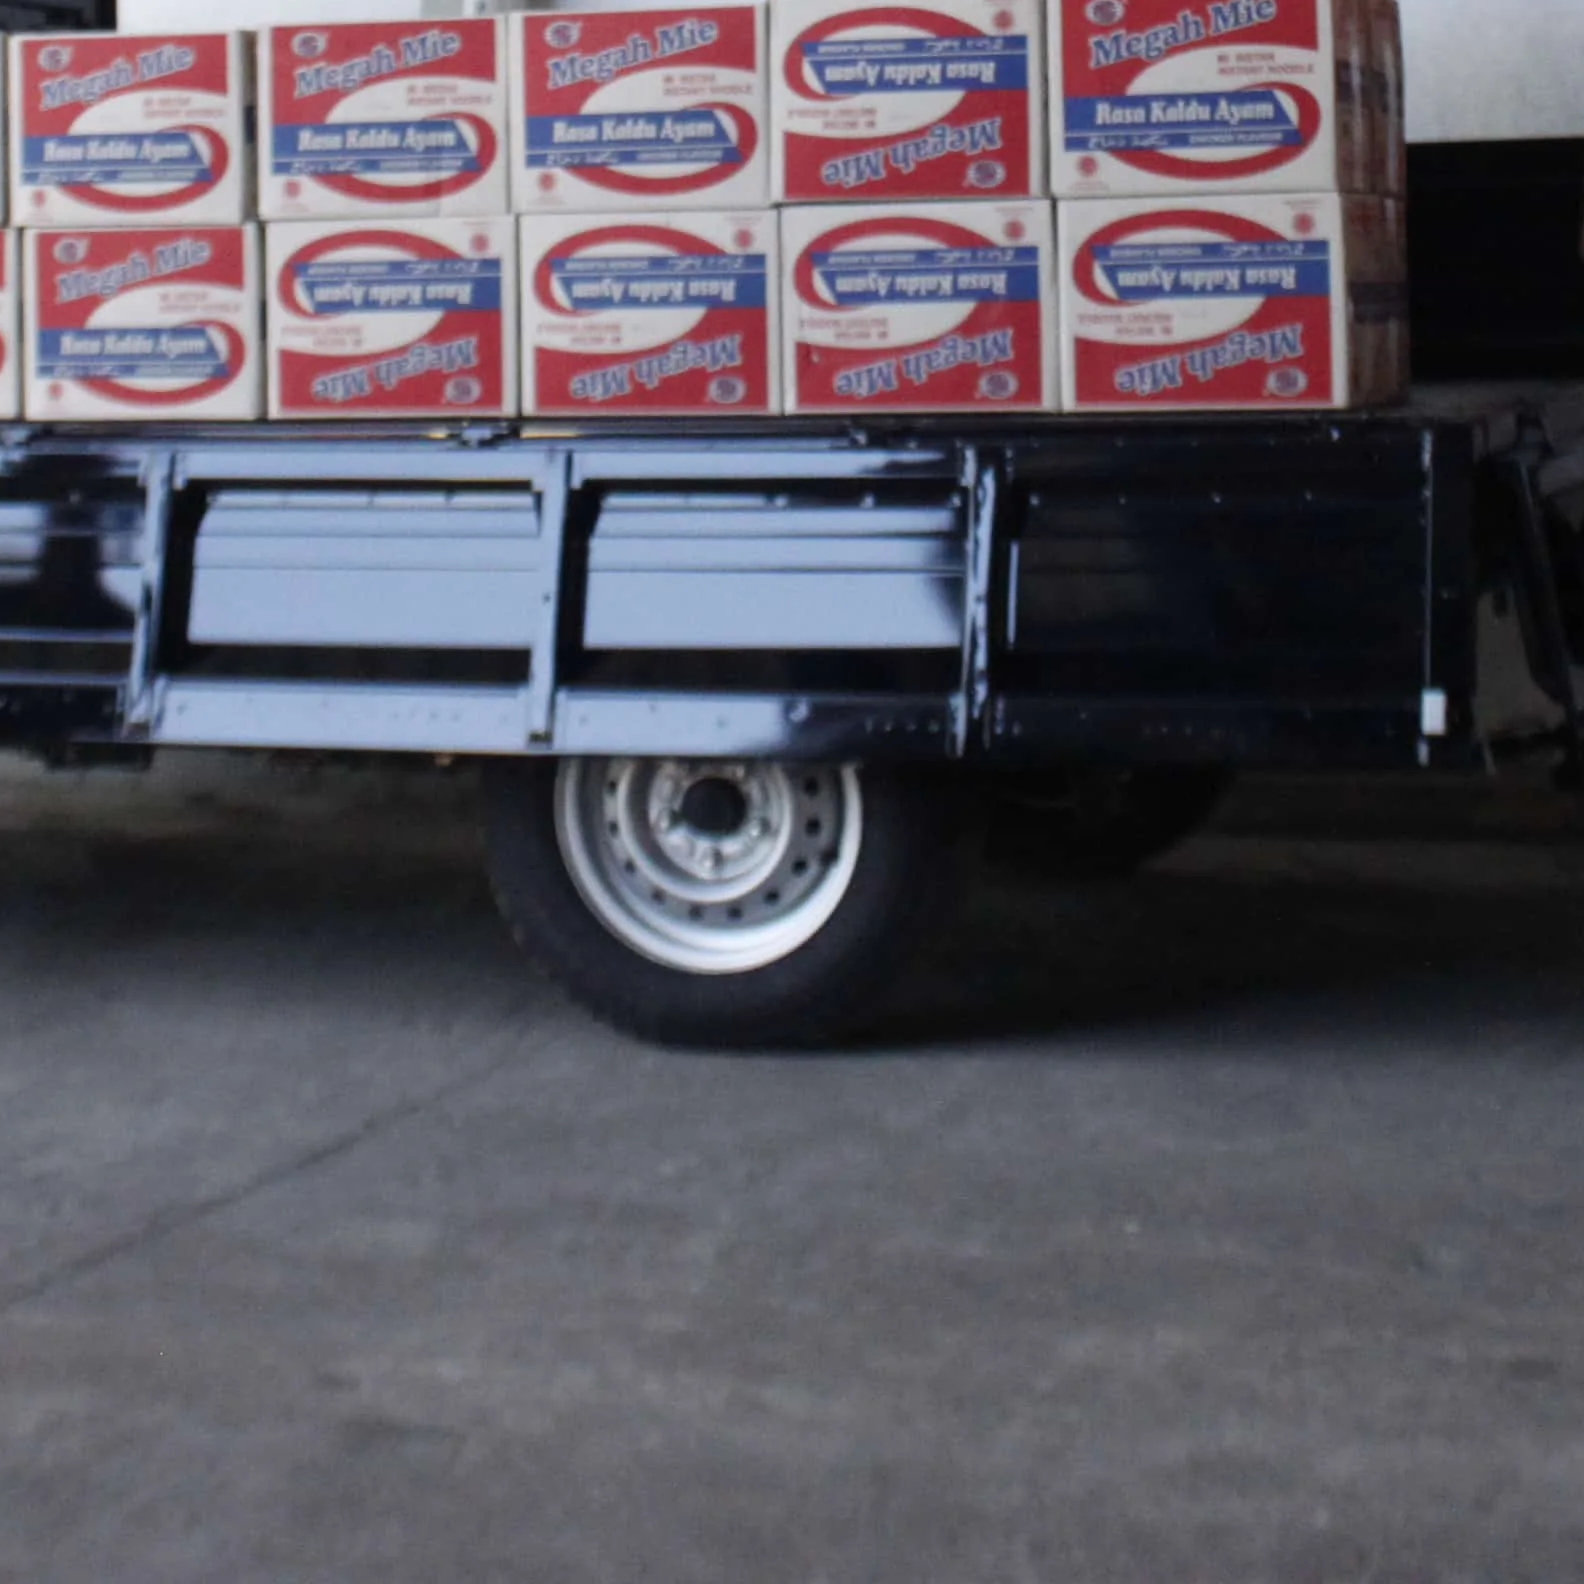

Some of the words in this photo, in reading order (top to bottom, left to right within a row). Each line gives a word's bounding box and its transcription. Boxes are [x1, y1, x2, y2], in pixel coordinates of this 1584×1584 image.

[546, 32, 654, 91] Megah
[655, 17, 719, 57] Mie
[1088, 10, 1205, 71] Megah
[38, 56, 135, 111] Megah
[137, 44, 195, 81] Mie
[293, 43, 396, 100] Megah
[400, 29, 462, 68] Mie
[824, 61, 881, 87] Ayam
[884, 62, 942, 86] Kaldu
[946, 61, 996, 84] Rasa
[1095, 103, 1146, 126] Rasa
[1150, 100, 1211, 124] Kaldu
[1216, 98, 1275, 126] Ayam
[297, 127, 342, 151] Rasa
[346, 127, 400, 149] Kaldu
[403, 126, 456, 153] Ayam
[553, 120, 598, 143] Rasa
[602, 119, 657, 141] Kaldu
[660, 118, 716, 143] Ayam
[888, 116, 1003, 175] Megah
[820, 149, 887, 189] Mie
[55, 249, 151, 304] Megah
[153, 237, 212, 274] Mie
[835, 271, 892, 297] Ayam
[895, 272, 953, 296] Kaldu
[958, 271, 1007, 294] Rasa
[1118, 264, 1176, 291] Ayam
[1179, 266, 1240, 290] Kaldu
[1245, 265, 1296, 289] Rasa
[571, 278, 625, 303] Ayam
[628, 280, 685, 302] Kaldu
[689, 279, 736, 301] Rasa
[373, 332, 480, 391] Megah
[633, 330, 744, 389] Megah
[902, 326, 1014, 385] Megah
[1185, 322, 1302, 381] Megah
[310, 366, 373, 402] Mie
[568, 363, 632, 402] Mie
[832, 359, 898, 398] Mie
[1114, 354, 1182, 394] Mie
